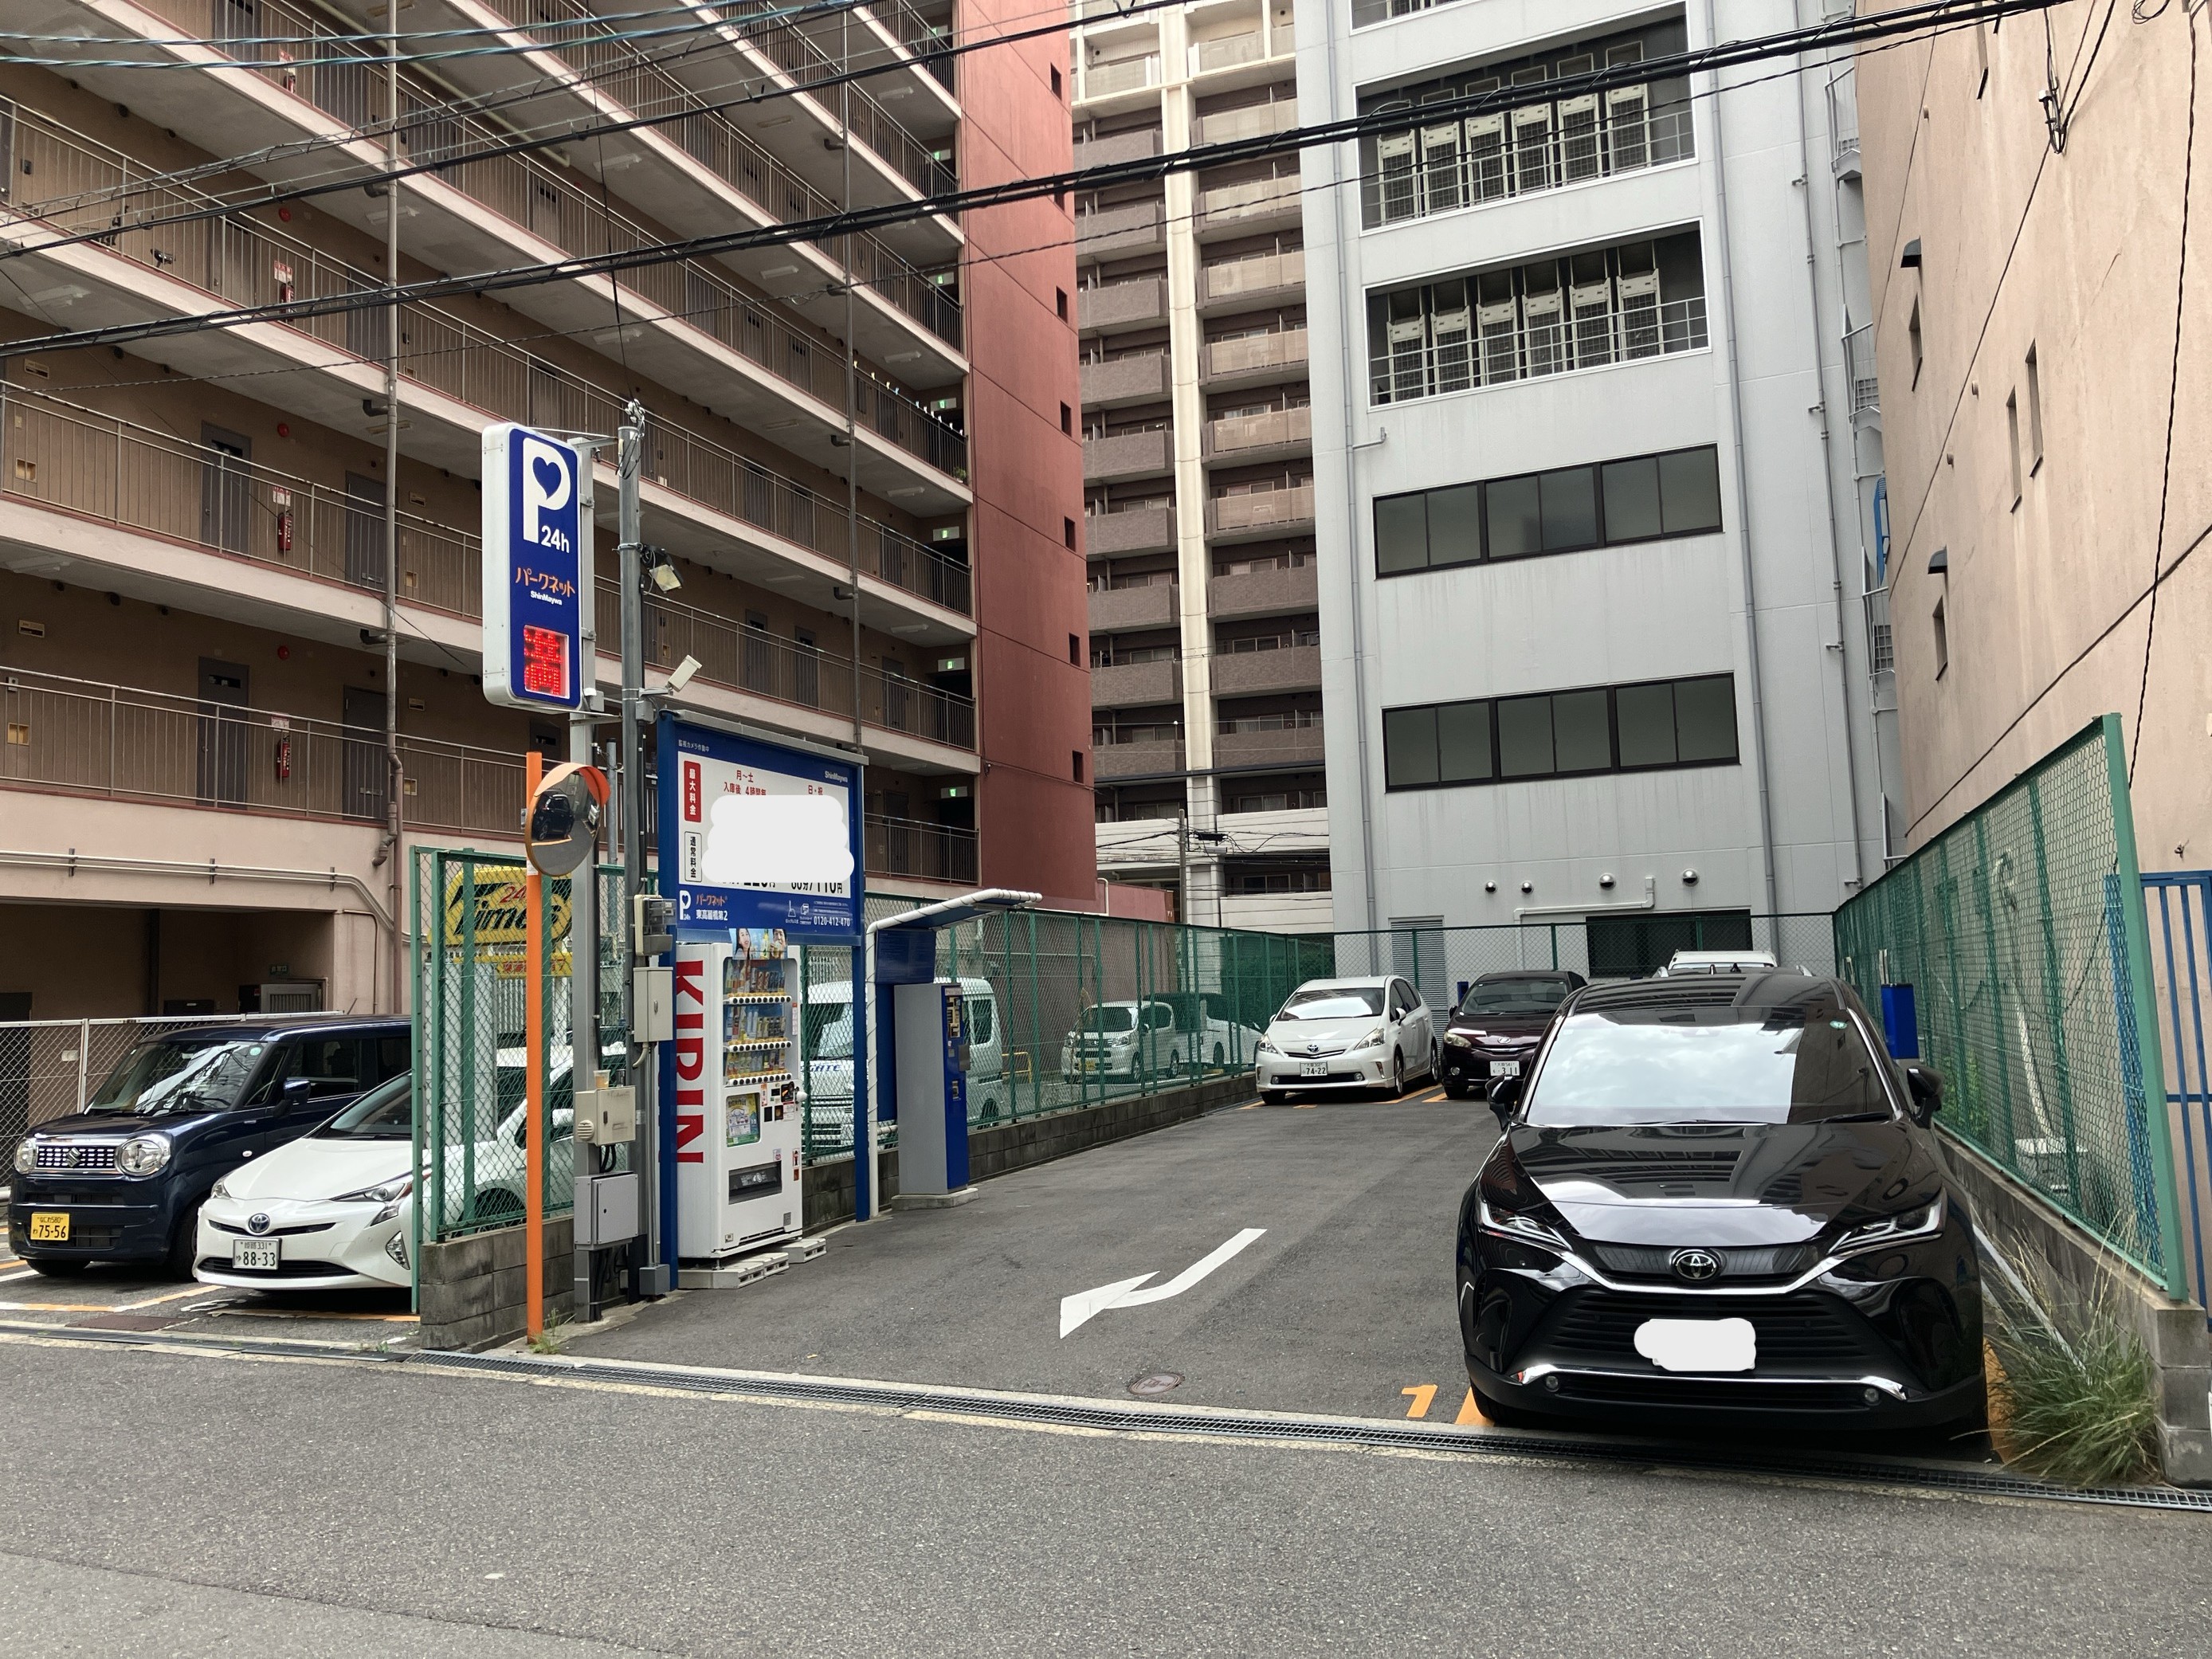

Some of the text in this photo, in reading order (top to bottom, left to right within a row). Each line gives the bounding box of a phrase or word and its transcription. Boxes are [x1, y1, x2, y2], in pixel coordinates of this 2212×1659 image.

[523, 437, 571, 544] P
[541, 525, 570, 554] 24h
[515, 567, 576, 598] パークネット
[530, 590, 563, 606] ShinMaywa
[825, 771, 848, 782] ShinMaywa
[808, 785, 823, 795] 日・祝
[696, 893, 726, 907] パークネット
[814, 916, 851, 928] 0120-412-470
[677, 960, 704, 1163] KIRIN
[39, 1225, 66, 1238] 75-56
[243, 1251, 276, 1266] 88-33
